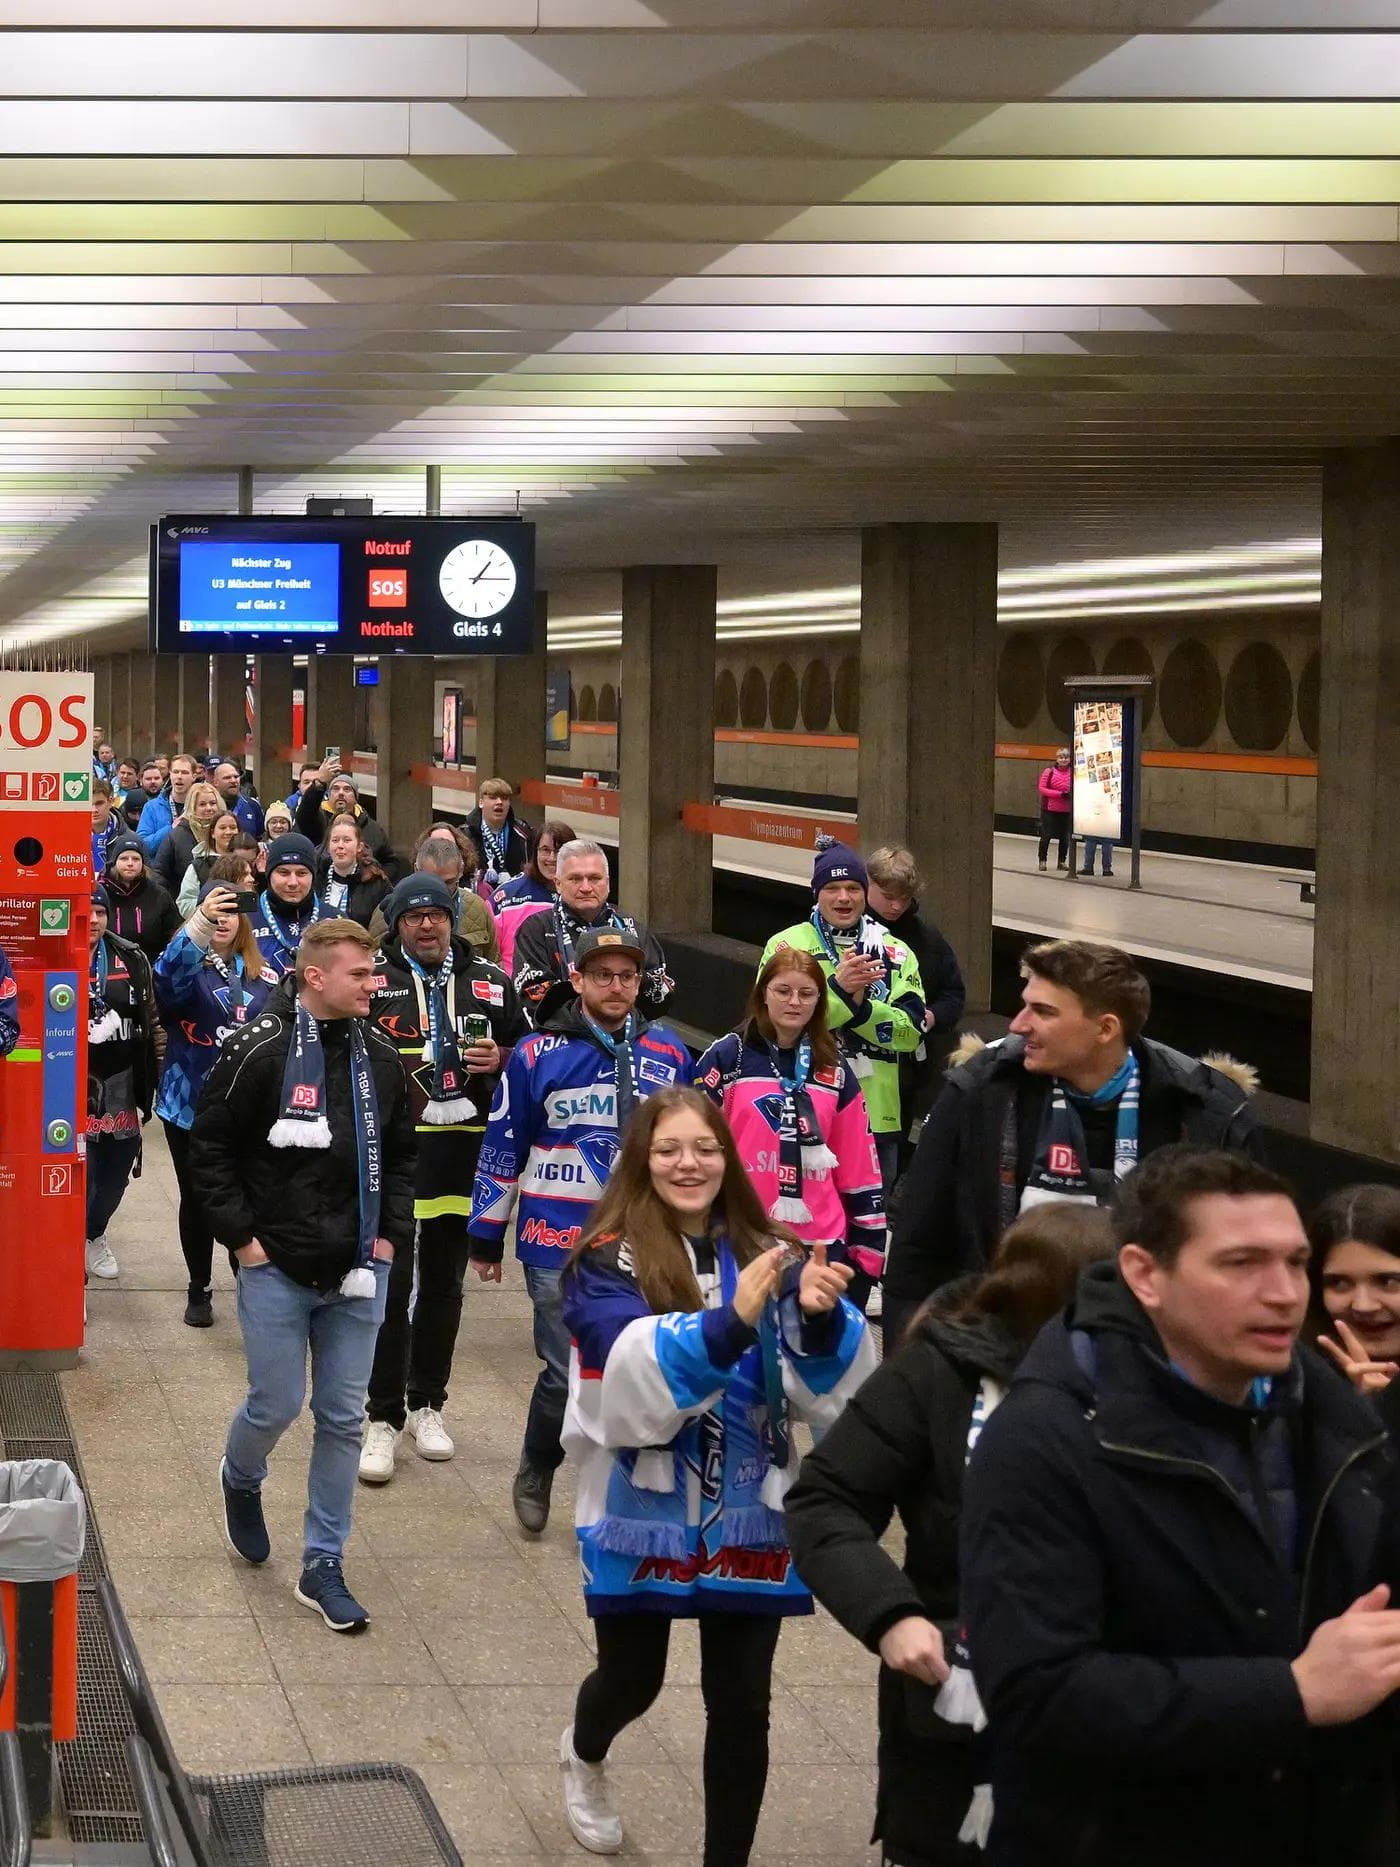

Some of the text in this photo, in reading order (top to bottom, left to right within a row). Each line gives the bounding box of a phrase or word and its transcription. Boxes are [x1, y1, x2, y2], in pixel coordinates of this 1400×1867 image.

[365, 540, 411, 555] Notruf
[232, 557, 291, 570] Nächster Zug
[212, 578, 311, 589] U3 Münchner Freiheit
[372, 580, 403, 596] SOS
[236, 600, 285, 610] auf Gleis 2
[361, 622, 414, 636] Nothalt
[453, 621, 502, 637] Gleis 4
[54, 854, 88, 864] Nothalt
[56, 867, 88, 877] Gleis 4
[831, 868, 849, 877] ERC
[378, 989, 409, 998] Bayern
[46, 1027, 76, 1037] Inforuf
[705, 1070, 721, 1087] DB
[357, 1071, 371, 1101] RBM
[295, 1086, 315, 1105] DB
[363, 1112, 375, 1137] ERC
[367, 1147, 380, 1192] 22.01.23
